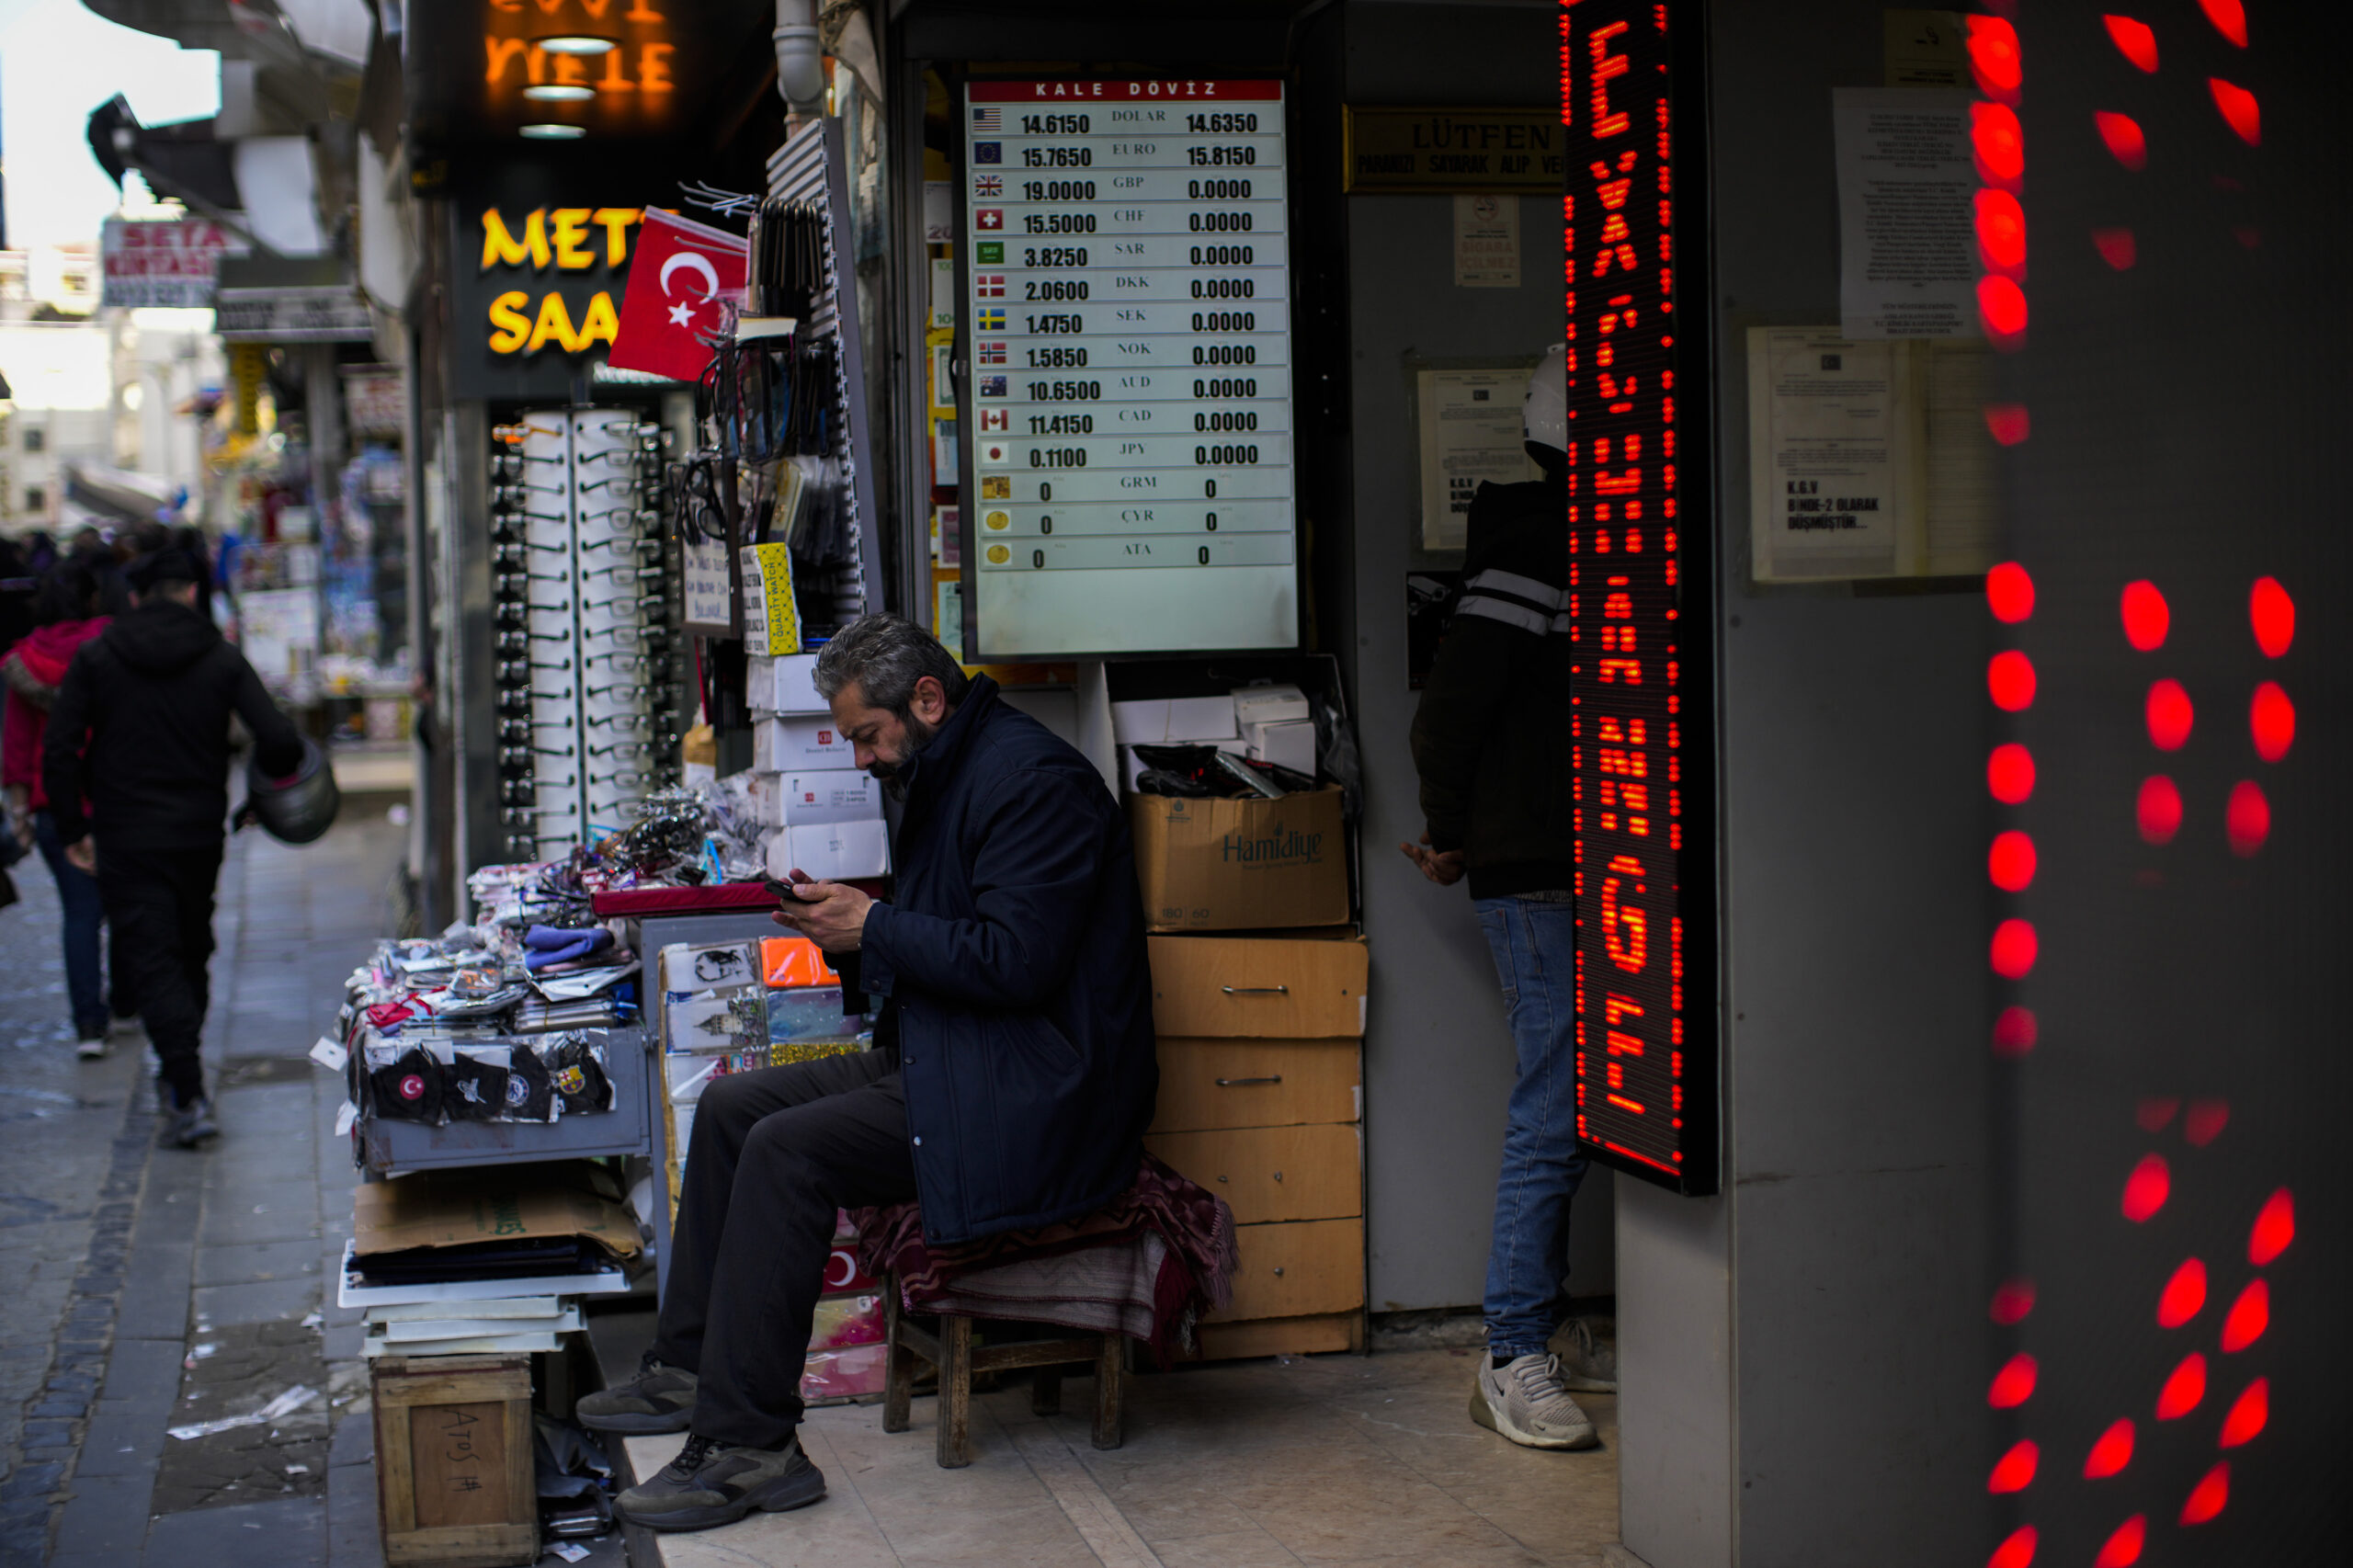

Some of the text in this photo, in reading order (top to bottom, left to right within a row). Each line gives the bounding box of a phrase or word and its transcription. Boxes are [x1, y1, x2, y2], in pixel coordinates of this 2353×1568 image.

[1036, 84, 1103, 96] KALE
[1021, 110, 1257, 133] 14.6150 DOLAR 14.6350
[1413, 119, 1551, 149] LÜTFEN
[1022, 143, 1256, 166] 15.7650 EURO 15.8150
[1500, 155, 1530, 174] ALIP
[1023, 176, 1251, 200] 19.0000 GBP 0.0000
[1024, 210, 1252, 233] 15.5000 CHF 0.0000
[481, 208, 678, 269] MET
[1025, 244, 1253, 267] 3.8250 SAR 0.0000
[1026, 277, 1254, 301] 2.0600 DKK 0.0000
[937, 314, 954, 324] 10
[1026, 310, 1254, 334] 1.4750 SEK 0.0000
[1028, 344, 1255, 367] 1.5850 NOK 0.0000
[1028, 377, 1256, 400] 10.6500 AUD 0.0000
[1029, 410, 1256, 434] 11.4150 CAD 0.0000
[1030, 443, 1257, 467] 0.1100 JPY 0.0000
[1040, 477, 1216, 500] 0 GRM 0
[1836, 497, 1879, 512] OLARAK
[1041, 516, 1051, 534] 0
[1207, 513, 1217, 531] 0
[1033, 544, 1209, 567] 0 ATA 0
[1589, 20, 1650, 1115] EXCHANGE
[768, 561, 784, 638] QUALITY WATCH
[1222, 831, 1323, 865] Hamidiye
[1192, 908, 1210, 918] 60
